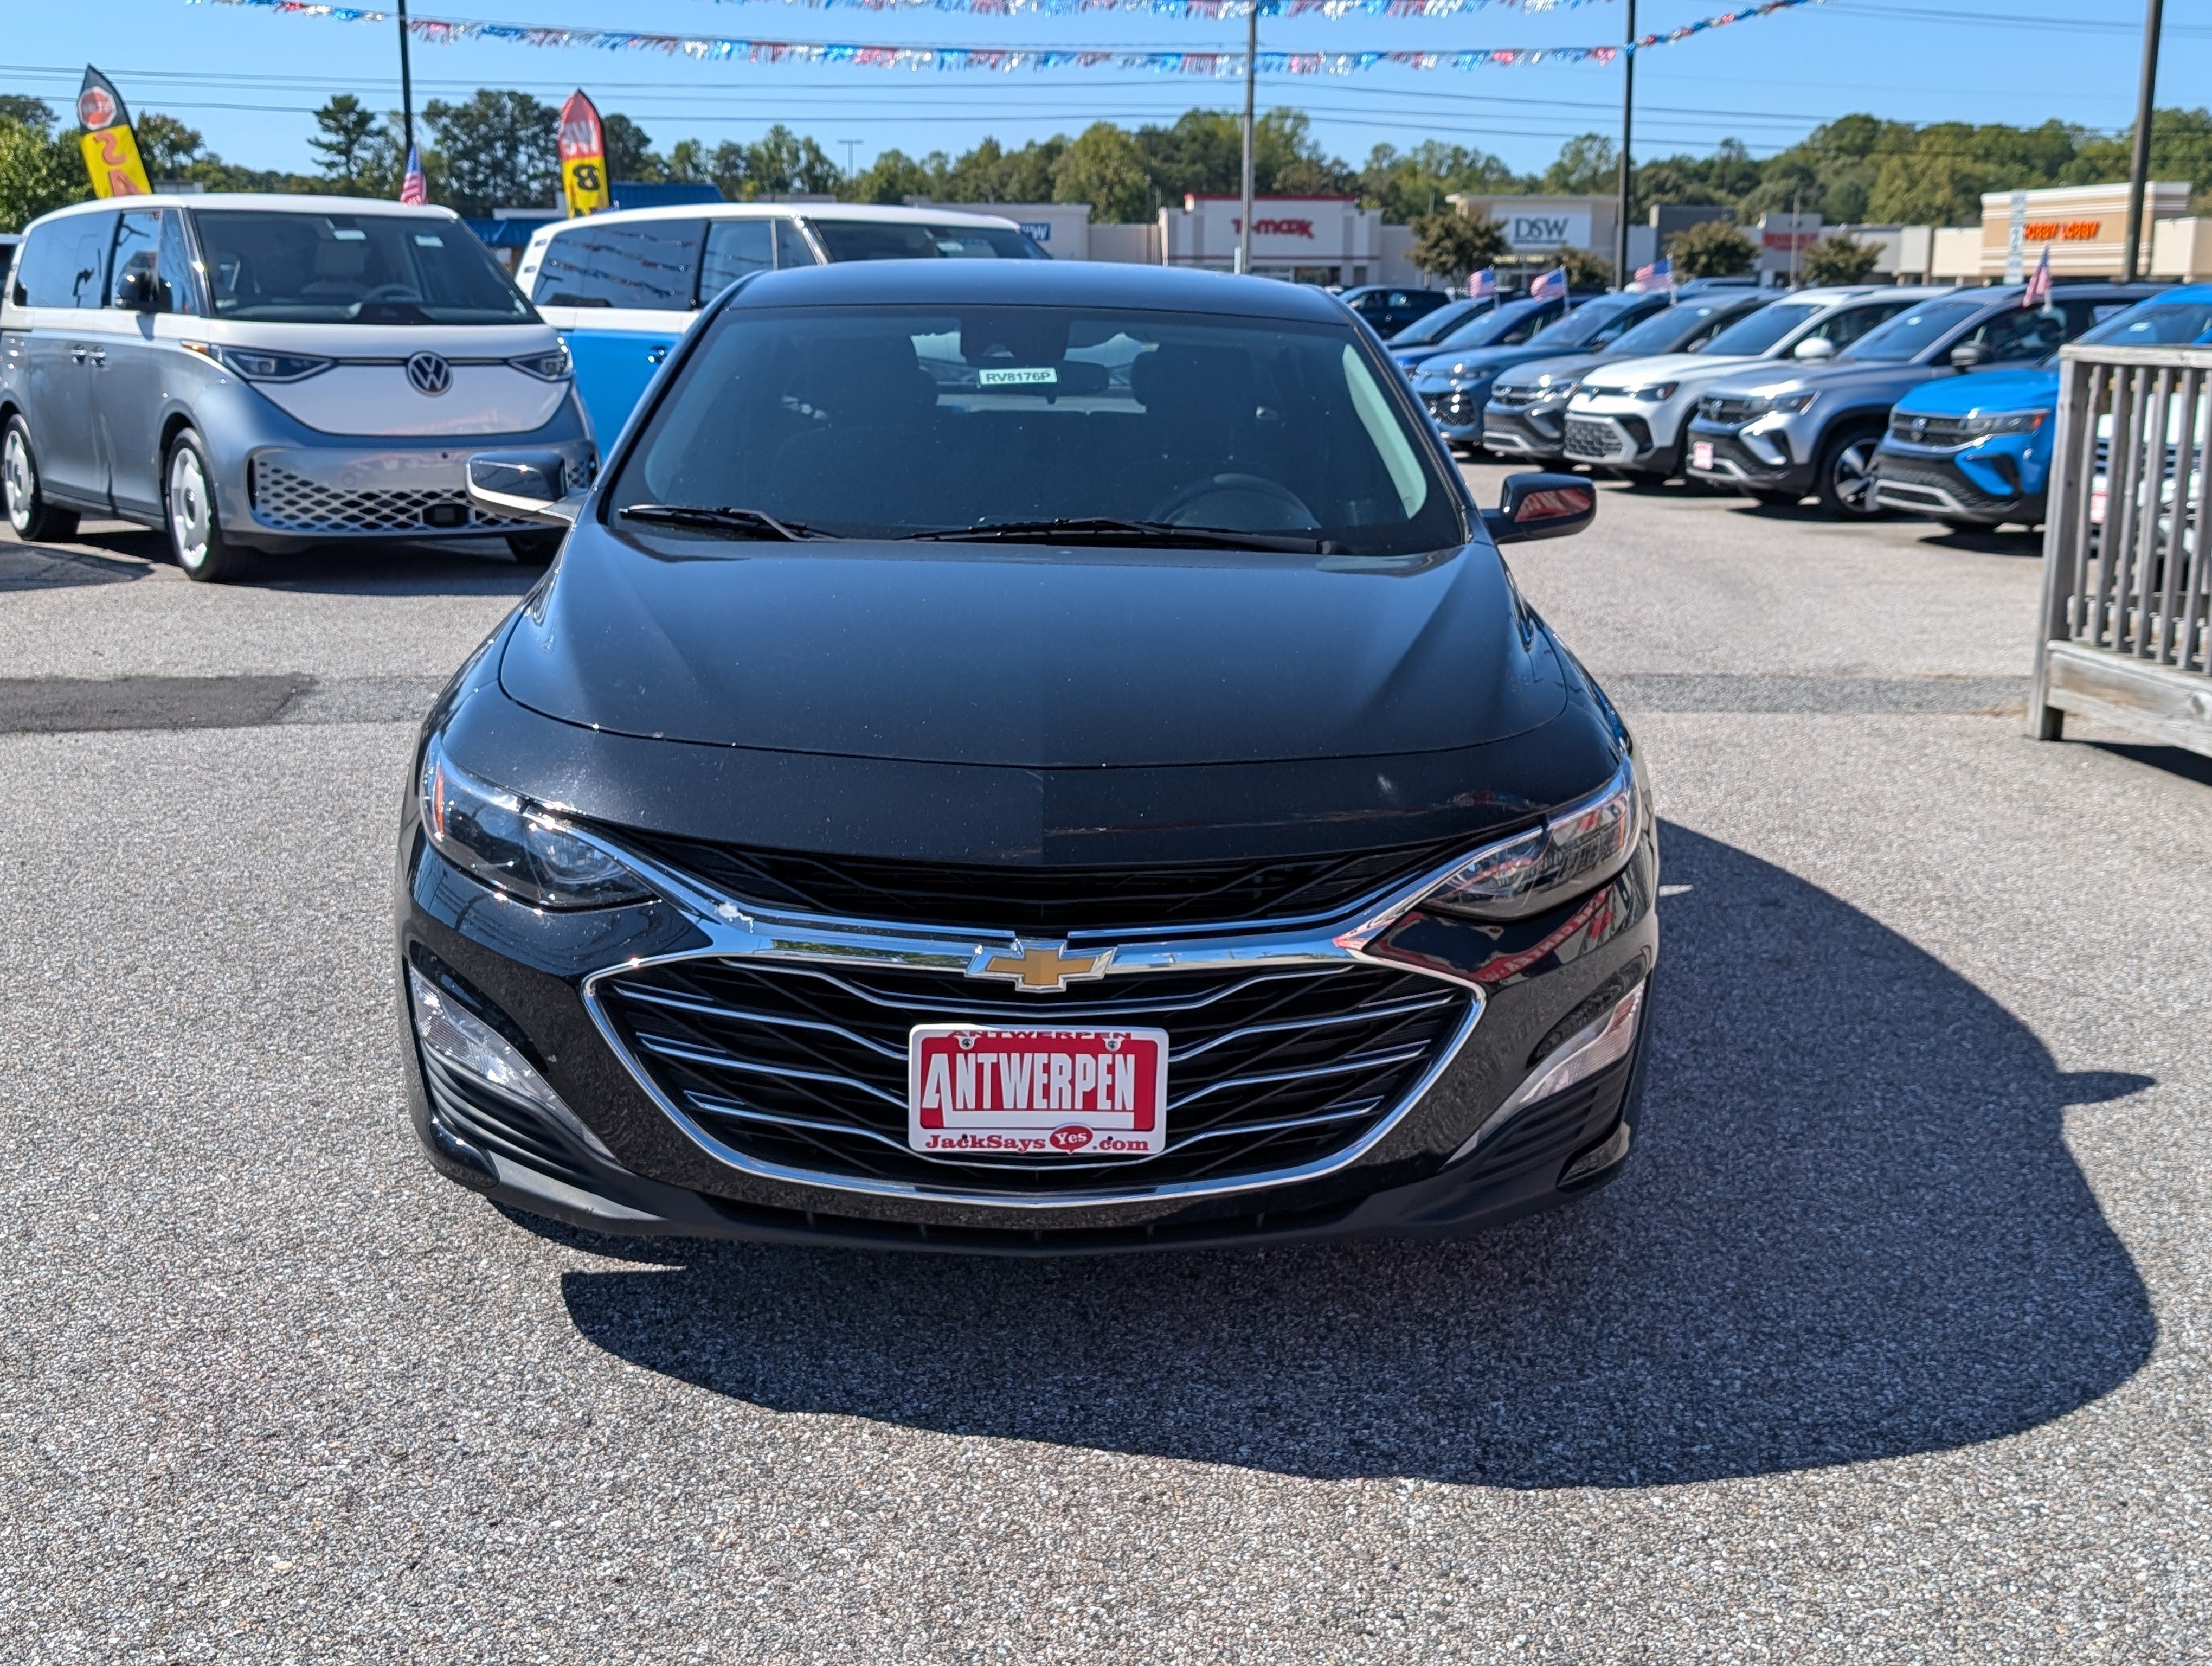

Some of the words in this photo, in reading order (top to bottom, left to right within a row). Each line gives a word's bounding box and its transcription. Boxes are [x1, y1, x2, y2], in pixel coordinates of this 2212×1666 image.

[1515, 218, 1570, 239] DSW
[2023, 222, 2059, 241] OBBY
[986, 371, 1051, 382] RV8176P
[922, 1053, 1135, 1111] ANTWERPEN
[1054, 1132, 1088, 1145] Yes
